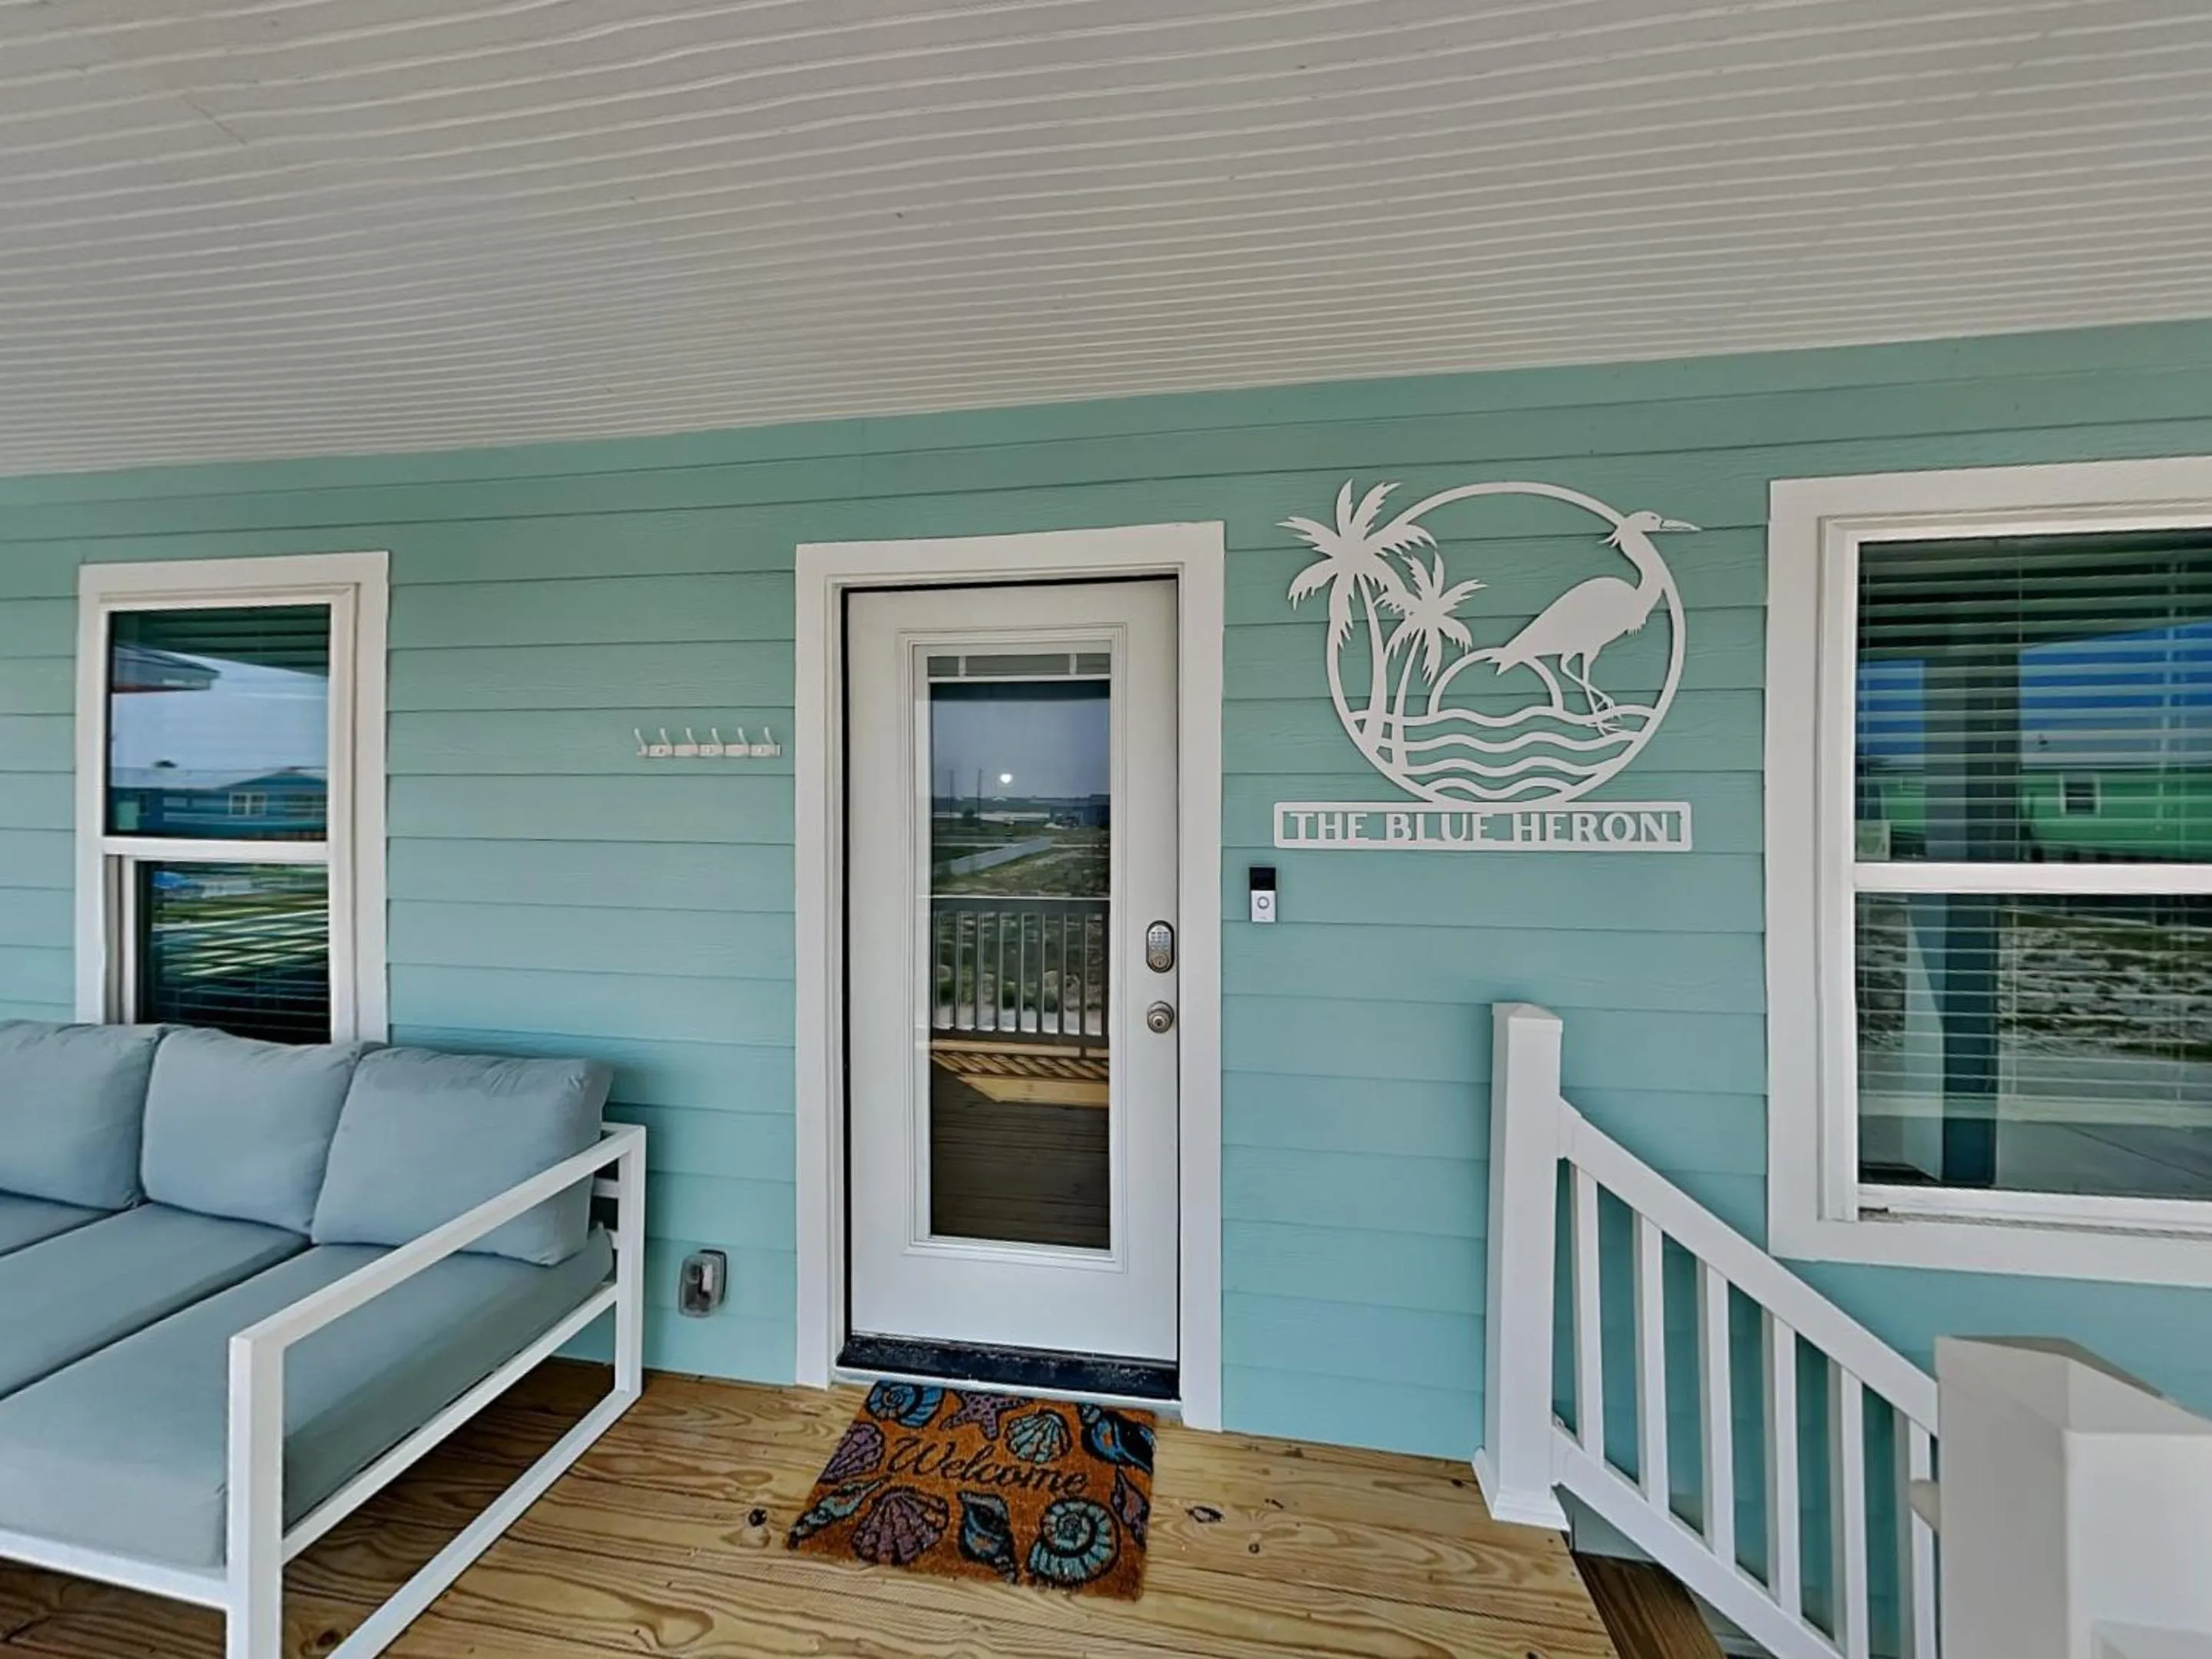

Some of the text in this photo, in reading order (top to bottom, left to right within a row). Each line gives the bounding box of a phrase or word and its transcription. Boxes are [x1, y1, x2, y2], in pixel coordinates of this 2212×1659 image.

[1290, 813, 1668, 843] THE BLUE HERON
[886, 1437, 1088, 1494] Welcome
